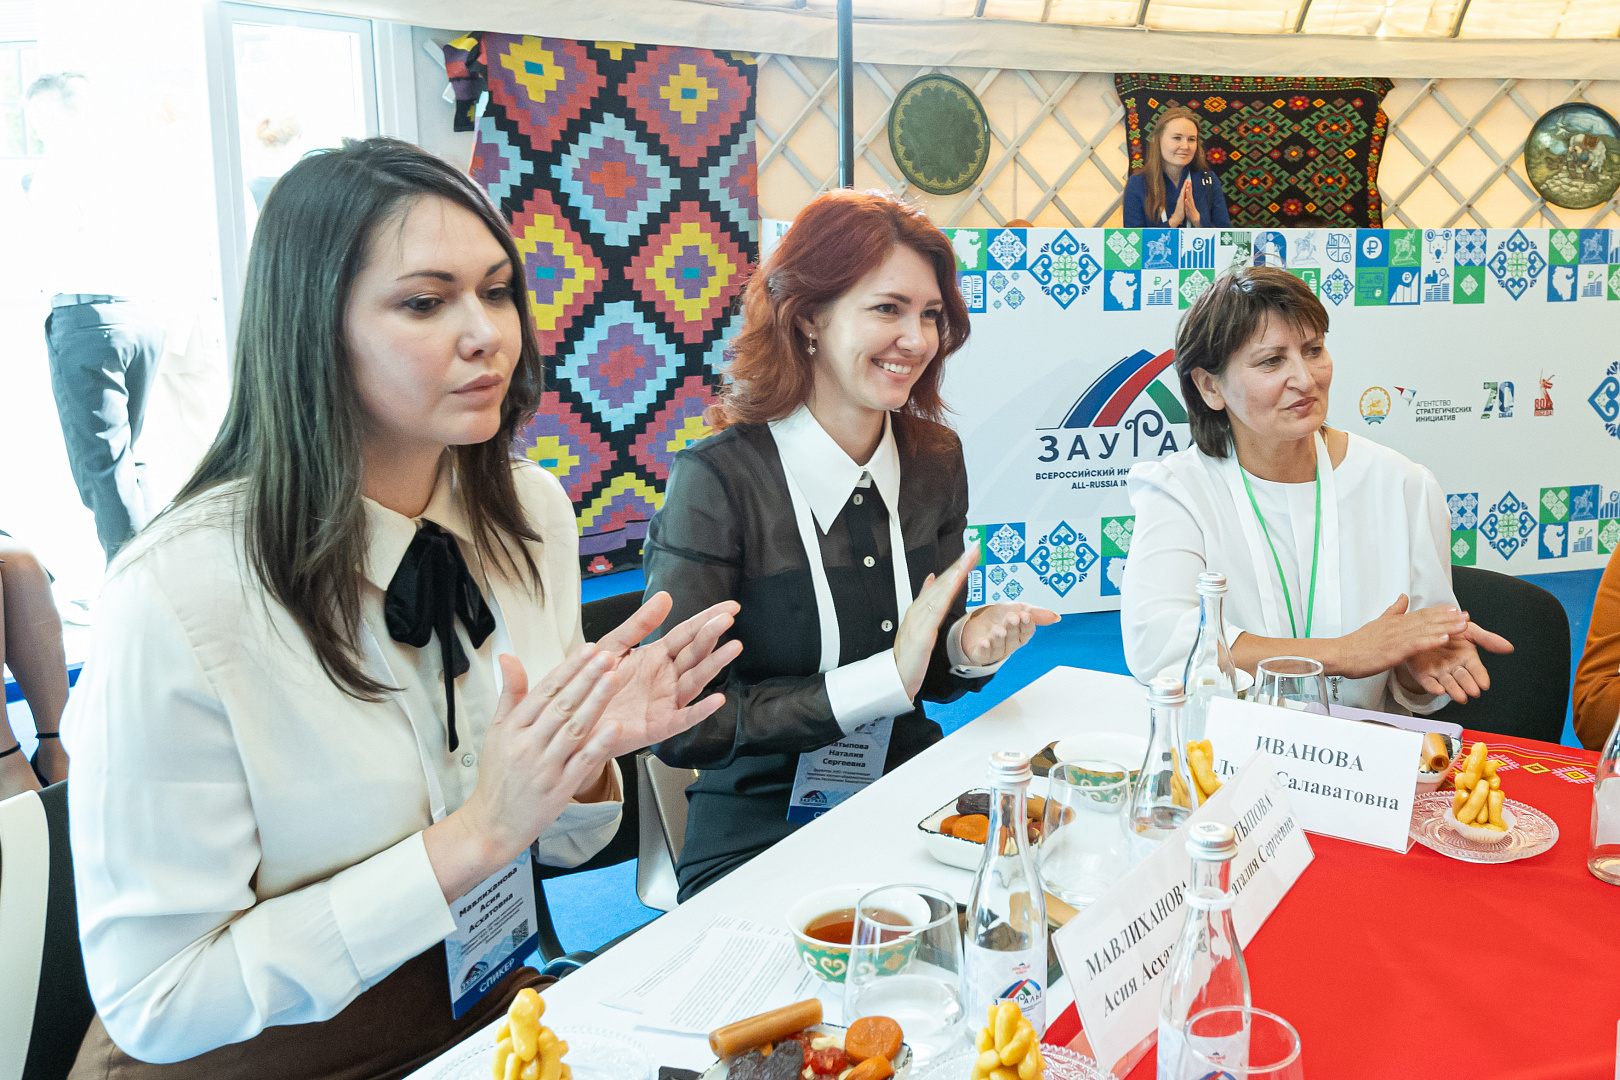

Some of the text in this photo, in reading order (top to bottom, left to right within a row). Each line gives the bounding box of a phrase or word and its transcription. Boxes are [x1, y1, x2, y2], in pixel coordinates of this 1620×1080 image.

[1415, 407, 1472, 415] СТРАТЕГИЧЕСКИХ
[1415, 414, 1456, 422] ИНИЦИАТИВ
[1416, 399, 1451, 407] АГЕНТСТВО
[1037, 409, 1194, 463] ЗАУРА
[1035, 467, 1132, 480] ВСЕРОССИЙСКИЙ ИН
[1071, 480, 1118, 490] ALL-RUSSIA
[822, 758, 866, 768] Сергеевна
[828, 749, 864, 758] Наталия
[1255, 735, 1364, 772] ИВАНОВА
[1213, 758, 1399, 811] Лу Салаватовна
[1234, 794, 1274, 846] ТЫПОВА
[1231, 817, 1295, 896] аталия Сергеевна
[458, 867, 518, 918] Мавлиханова
[479, 892, 501, 913] Асия
[468, 893, 514, 933] Асхатовна
[1085, 880, 1187, 981] МАВЛИХАНОВ
[479, 957, 515, 993] СПИКЕР
[1104, 977, 1138, 1018] Асия
